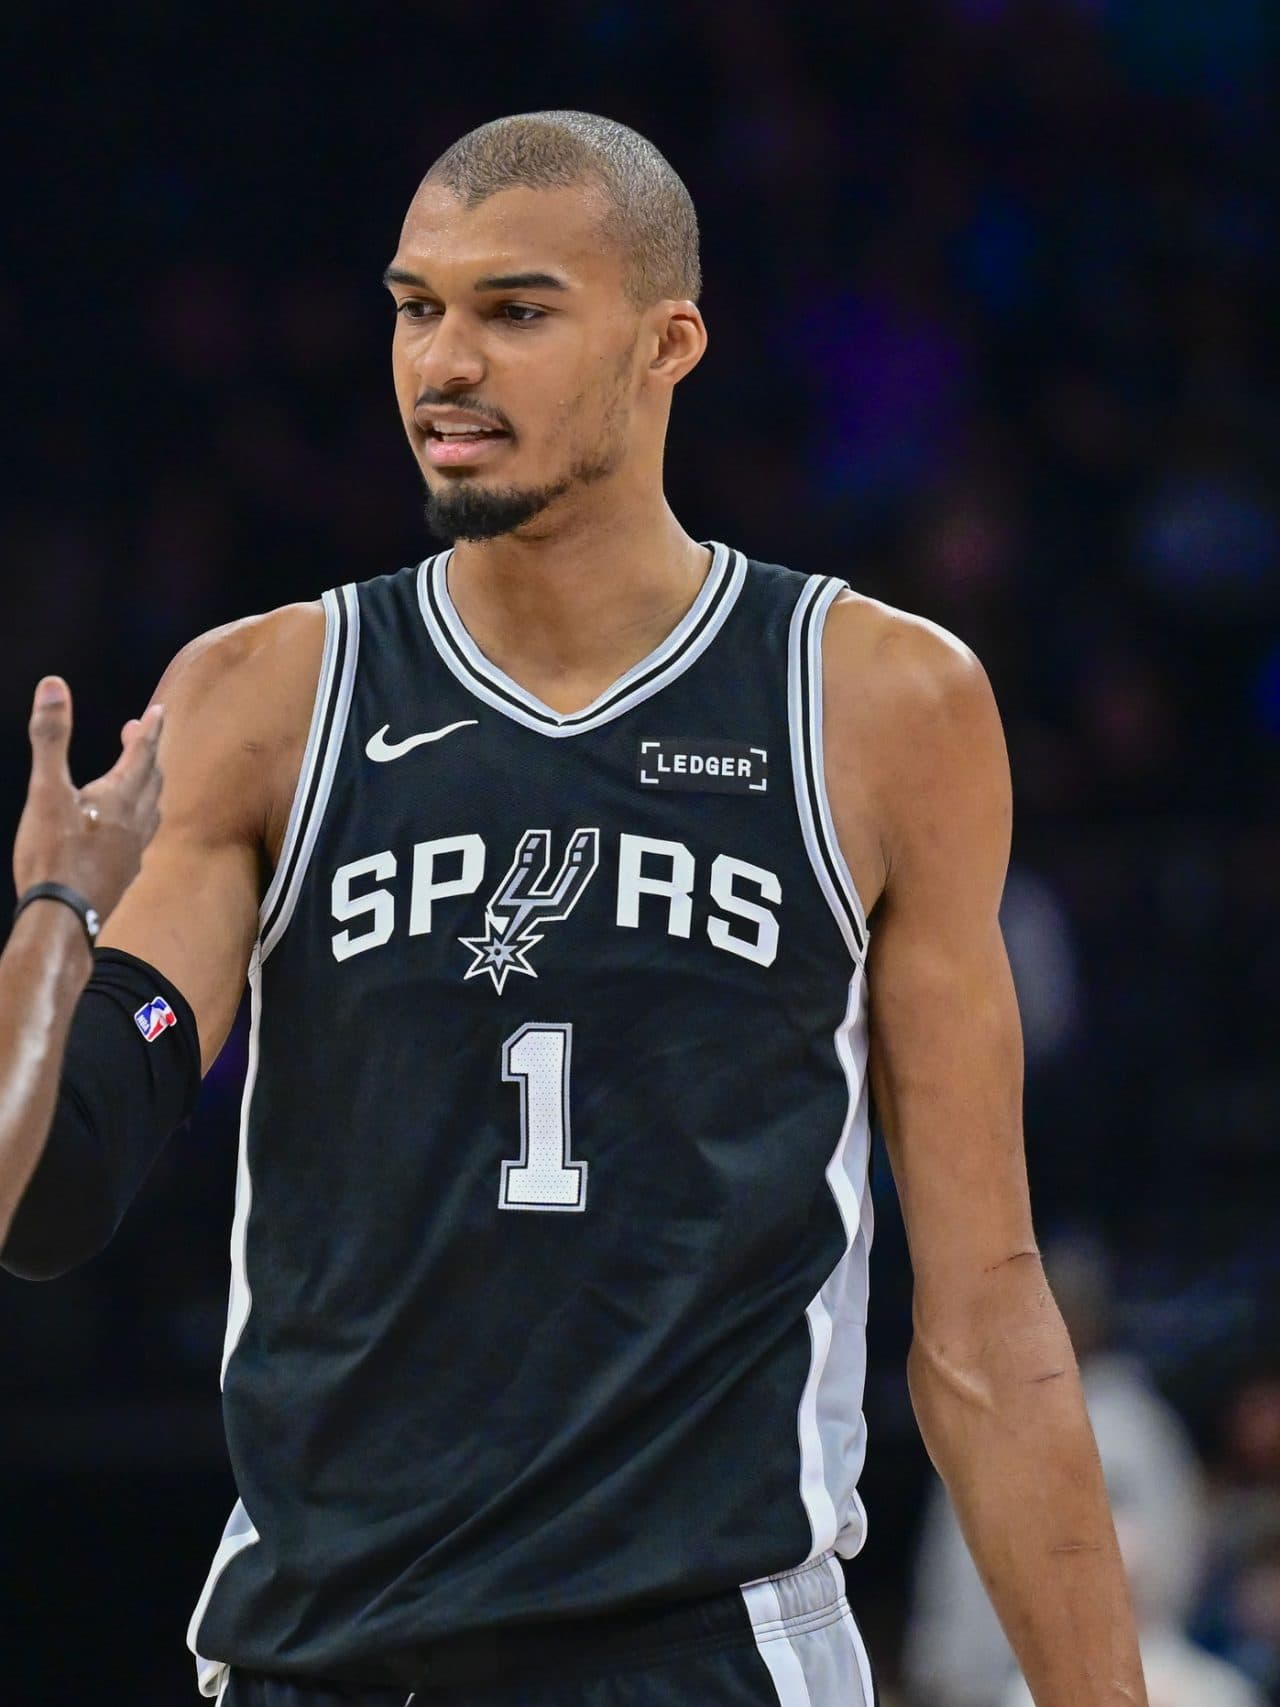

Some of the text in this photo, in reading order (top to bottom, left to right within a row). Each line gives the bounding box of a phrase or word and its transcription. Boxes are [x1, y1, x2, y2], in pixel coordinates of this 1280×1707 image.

[657, 753, 752, 778] LEDGER
[331, 828, 782, 995] SPURS
[498, 1022, 588, 1212] 1
